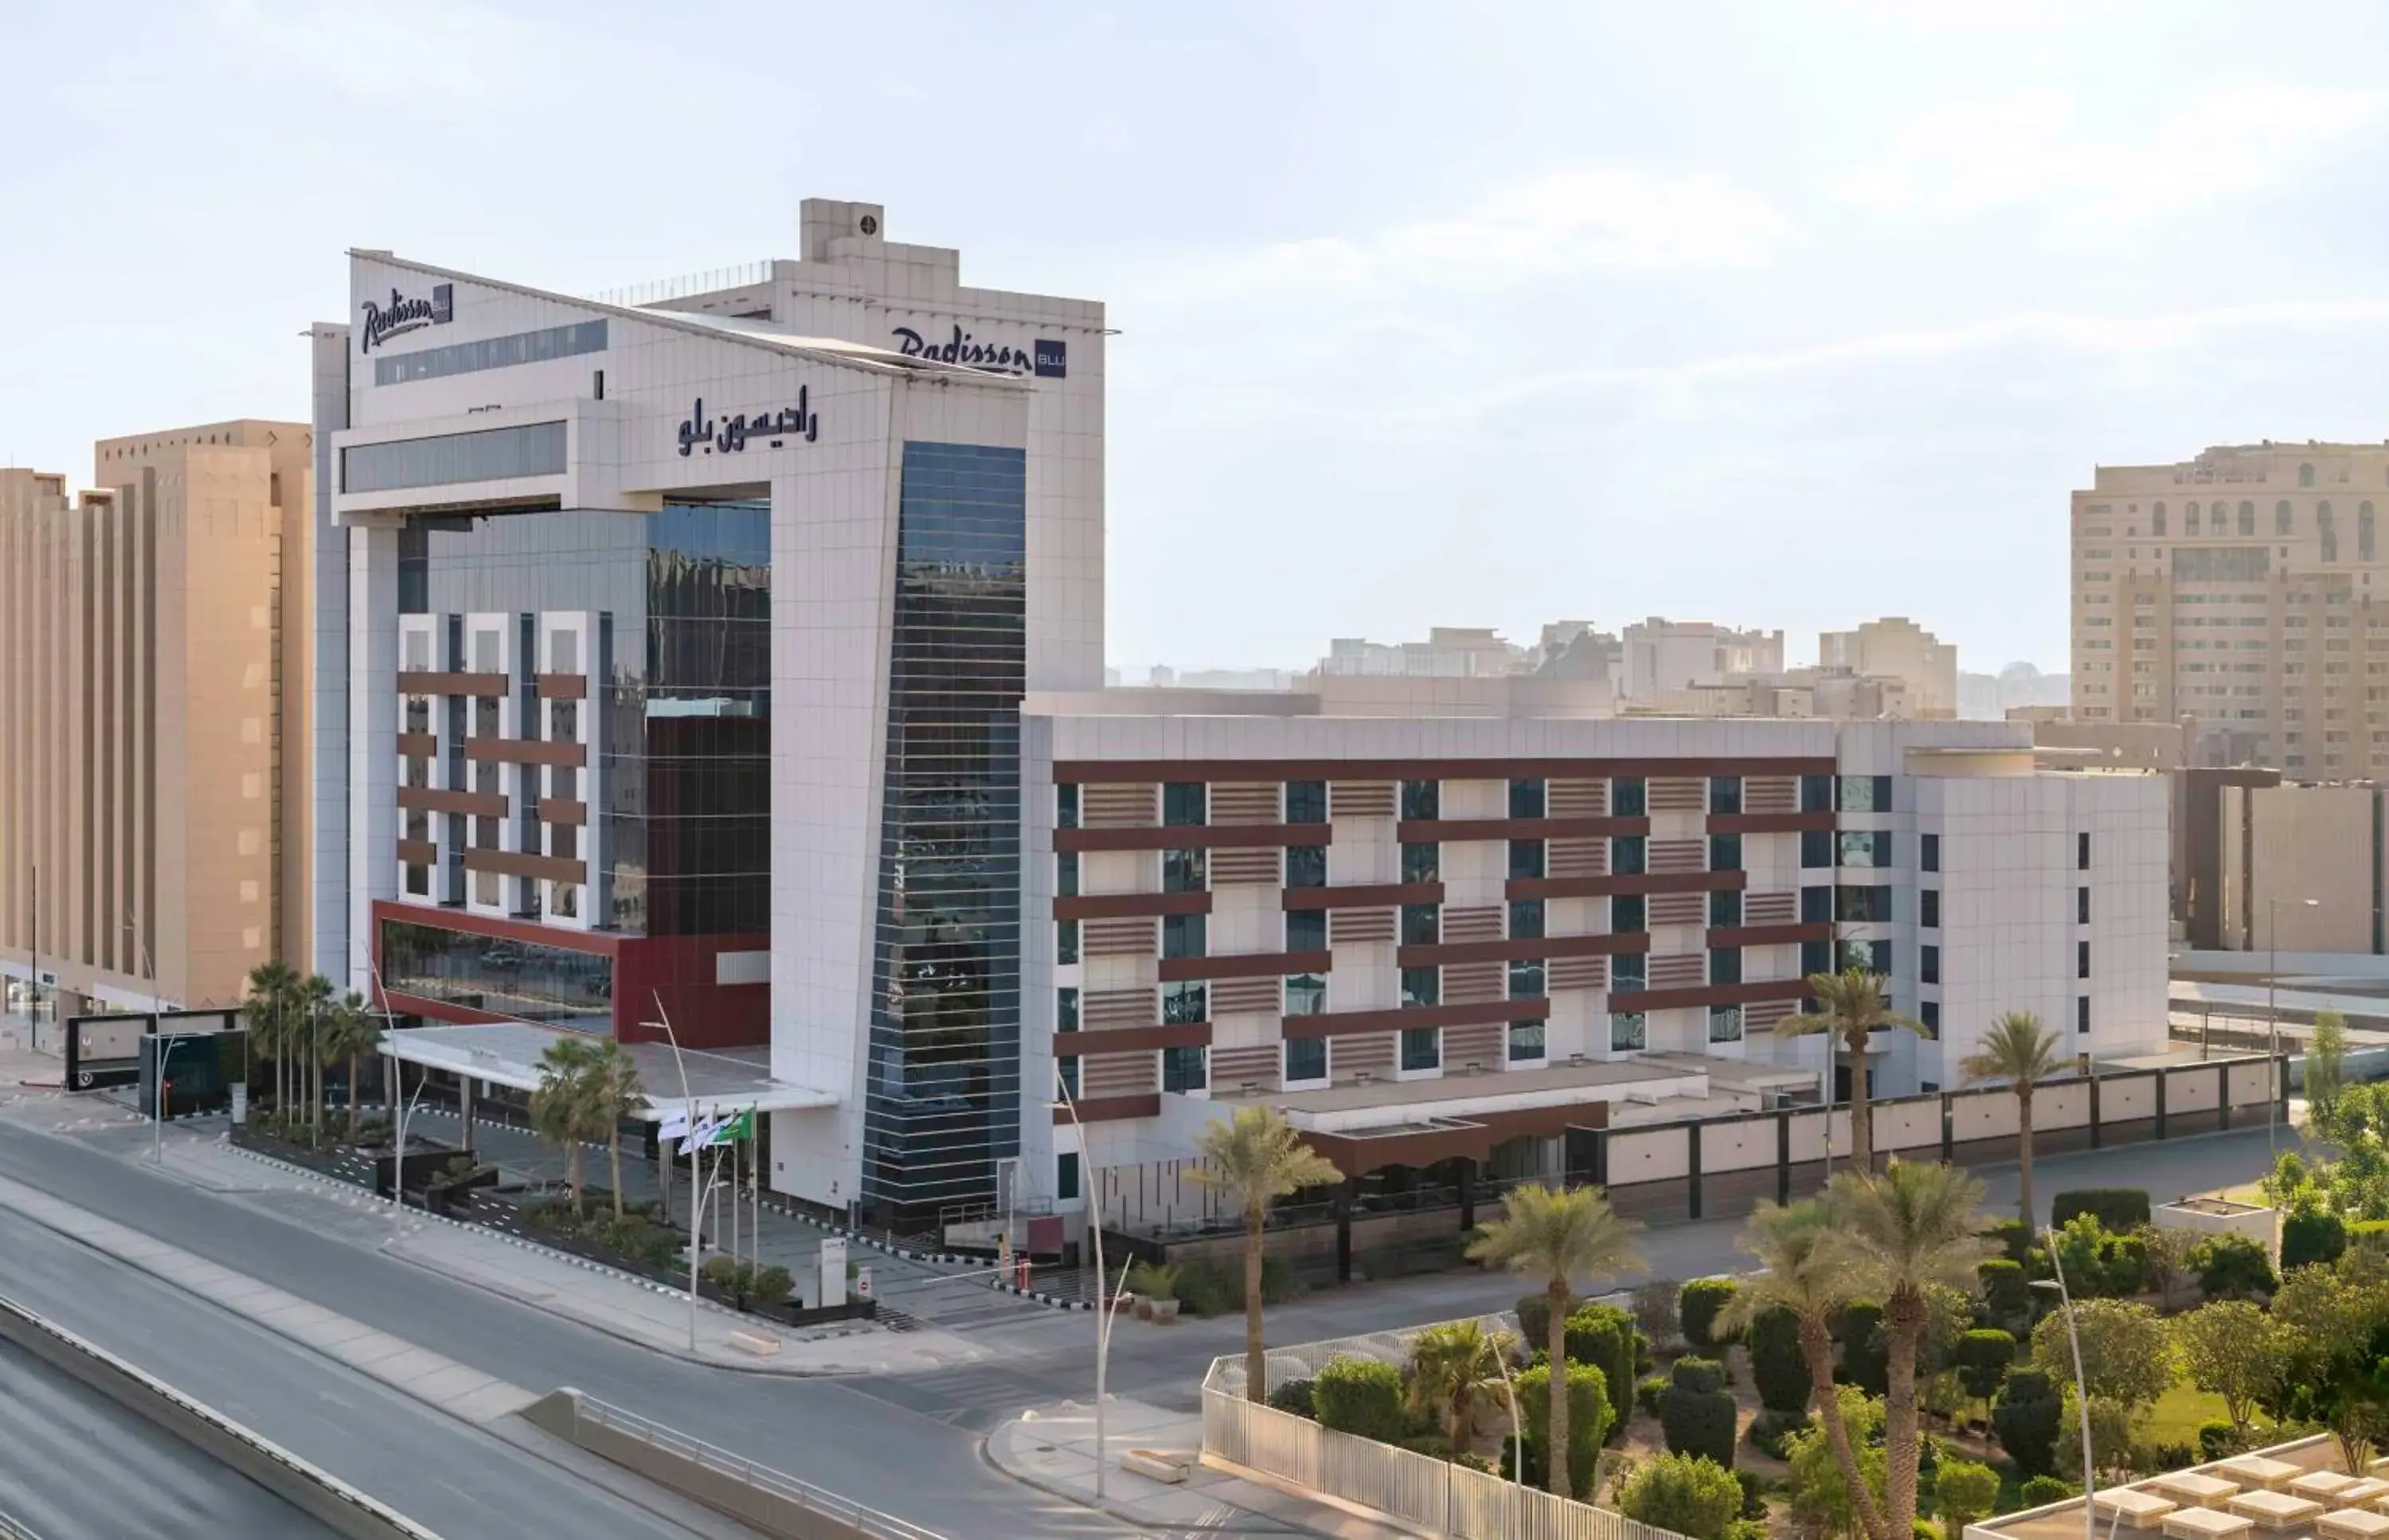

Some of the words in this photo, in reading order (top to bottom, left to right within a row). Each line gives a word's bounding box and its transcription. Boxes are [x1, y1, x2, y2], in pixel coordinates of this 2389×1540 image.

[361, 287, 434, 354] Radisson
[891, 322, 1033, 373] Radisson
[1038, 353, 1065, 367] BLU
[678, 397, 714, 458] بلو
[716, 385, 818, 454] راديسون
